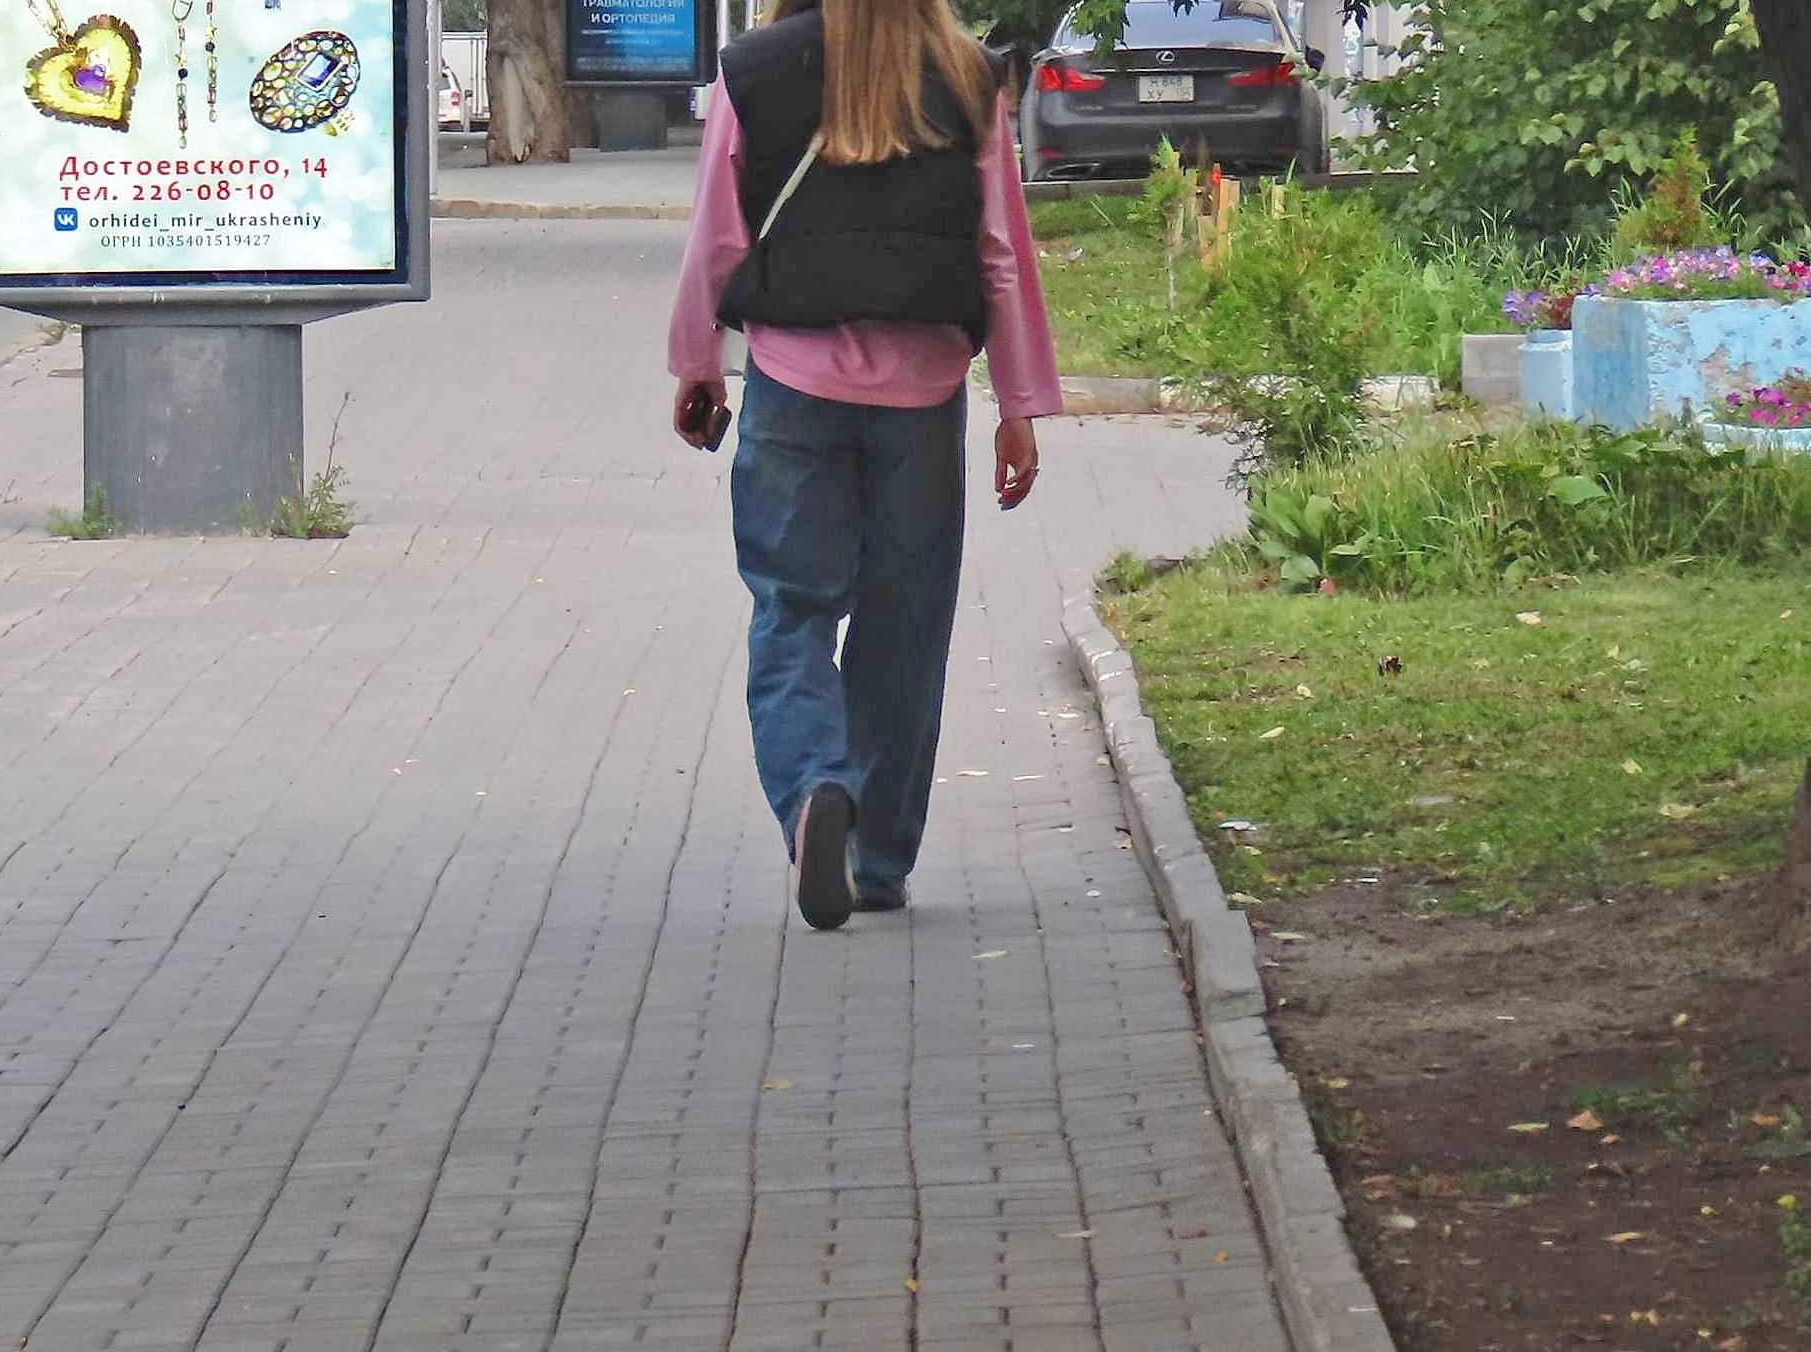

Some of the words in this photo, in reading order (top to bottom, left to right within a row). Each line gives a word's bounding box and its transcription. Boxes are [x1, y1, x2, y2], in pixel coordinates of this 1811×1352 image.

[591, 13, 600, 23] И
[602, 13, 676, 24] ОРТОПЕДИЯ
[59, 156, 290, 181] Достоевского,
[302, 158, 328, 178] 14
[60, 184, 118, 201] тел.
[133, 180, 274, 201] 226-08-10
[89, 213, 322, 232] orhidei_mir_ukrasheniy
[101, 235, 141, 248] ОГРН
[149, 234, 271, 247] 1035401519427
